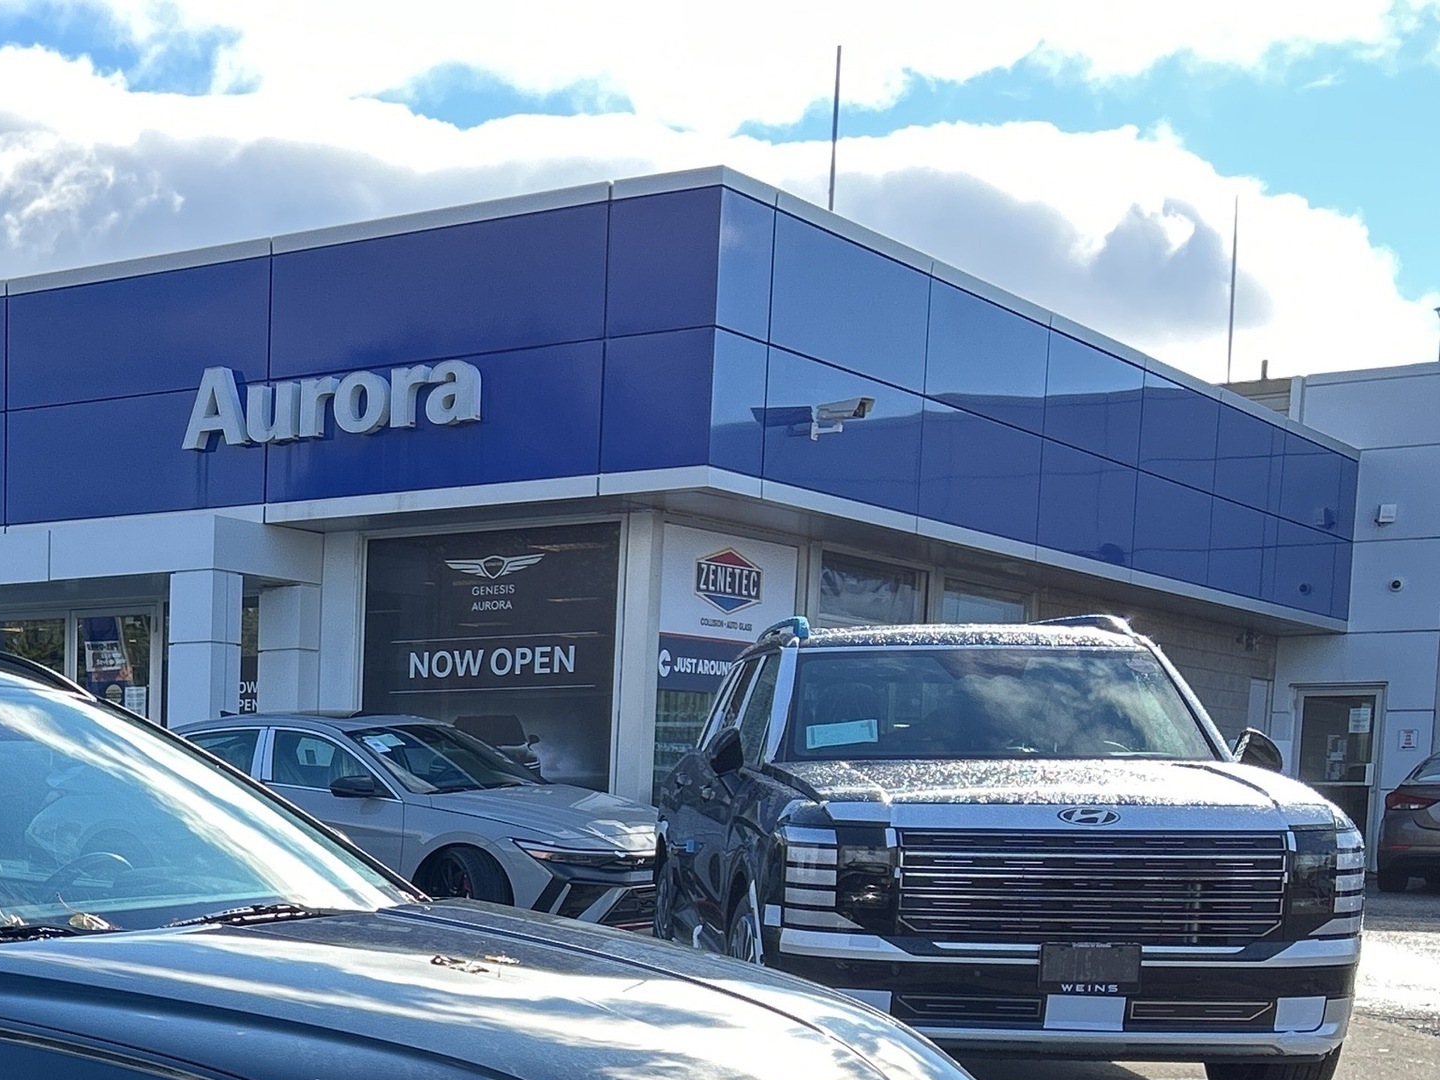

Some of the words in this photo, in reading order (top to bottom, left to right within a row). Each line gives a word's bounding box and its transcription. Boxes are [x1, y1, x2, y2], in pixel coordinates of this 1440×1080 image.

[181, 359, 482, 450] Aurora
[471, 584, 515, 596] GENESIS
[699, 563, 758, 597] ZENETEC
[471, 600, 513, 611] AURORA
[409, 649, 484, 679] NOW
[490, 645, 575, 676] OPEN
[673, 656, 698, 674] JUST
[697, 659, 732, 677] AROUN
[1061, 983, 1119, 993] WEINS
